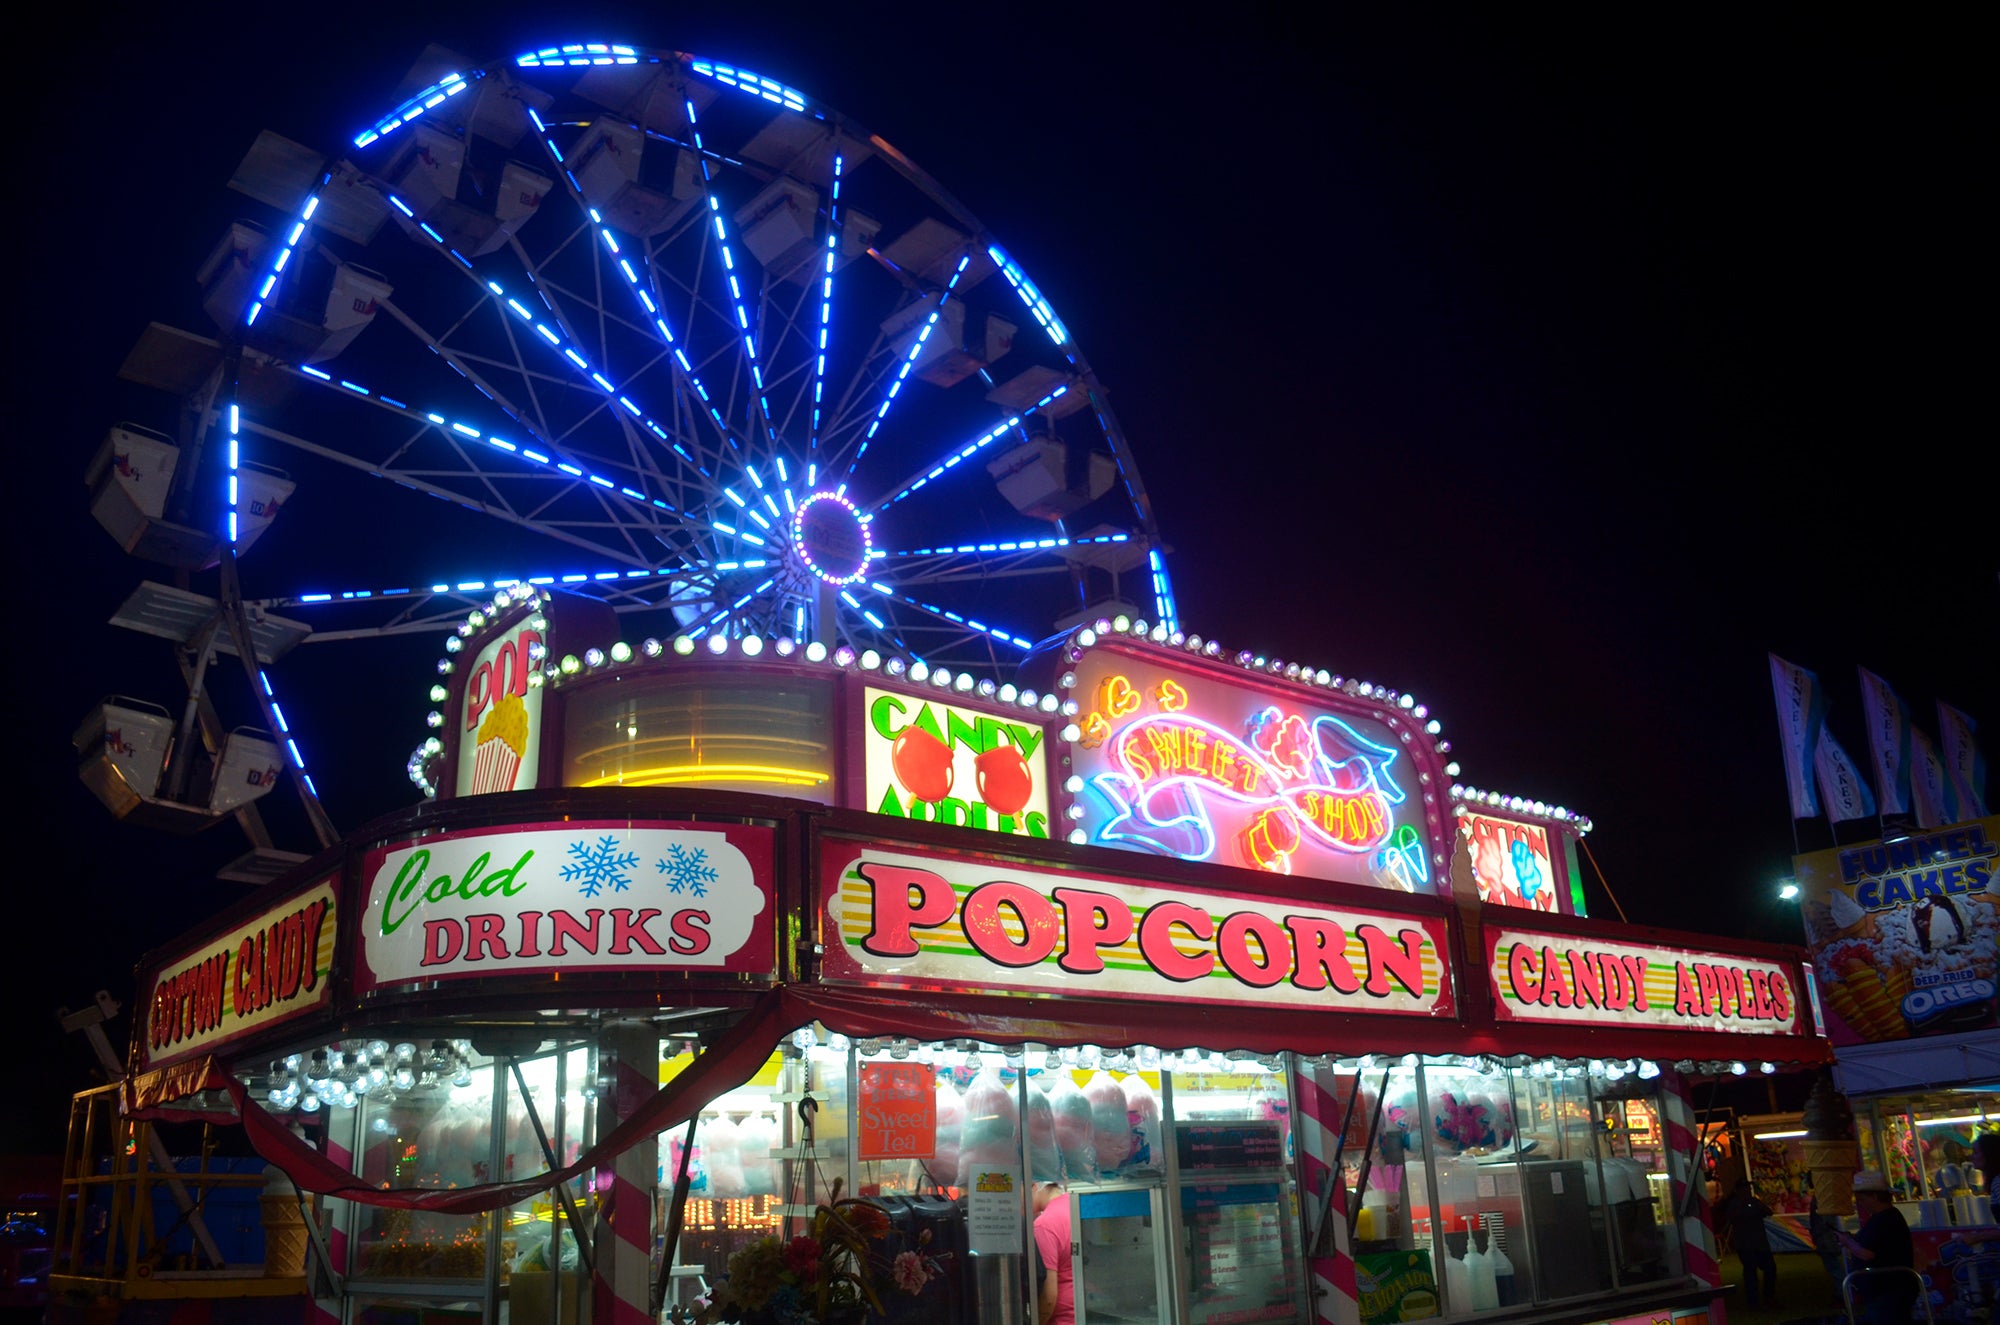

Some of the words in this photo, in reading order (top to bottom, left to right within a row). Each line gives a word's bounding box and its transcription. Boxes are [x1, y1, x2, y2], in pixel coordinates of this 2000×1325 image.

[467, 629, 542, 732] POP
[871, 695, 1043, 762] CANDY
[1124, 726, 1266, 793] SWEET
[1832, 751, 1853, 809] CAKES
[1301, 790, 1384, 841] SHOP
[1839, 826, 1996, 882] FUNNEL
[381, 849, 534, 936] Cold
[1856, 860, 1991, 910] CAKES
[420, 908, 711, 967] DRINKS
[856, 861, 1425, 998] POPCORN
[151, 950, 229, 1051] COTTON
[232, 896, 328, 1018] CANDY
[1508, 942, 1649, 1011] CANDY
[1674, 960, 1792, 1022] APPLES
[1903, 980, 1995, 1014] OREO
[1914, 974, 1940, 986] DEEP
[1943, 970, 1974, 982] FRIED
[865, 1105, 930, 1130] Sweet
[878, 1129, 916, 1153] Tea
